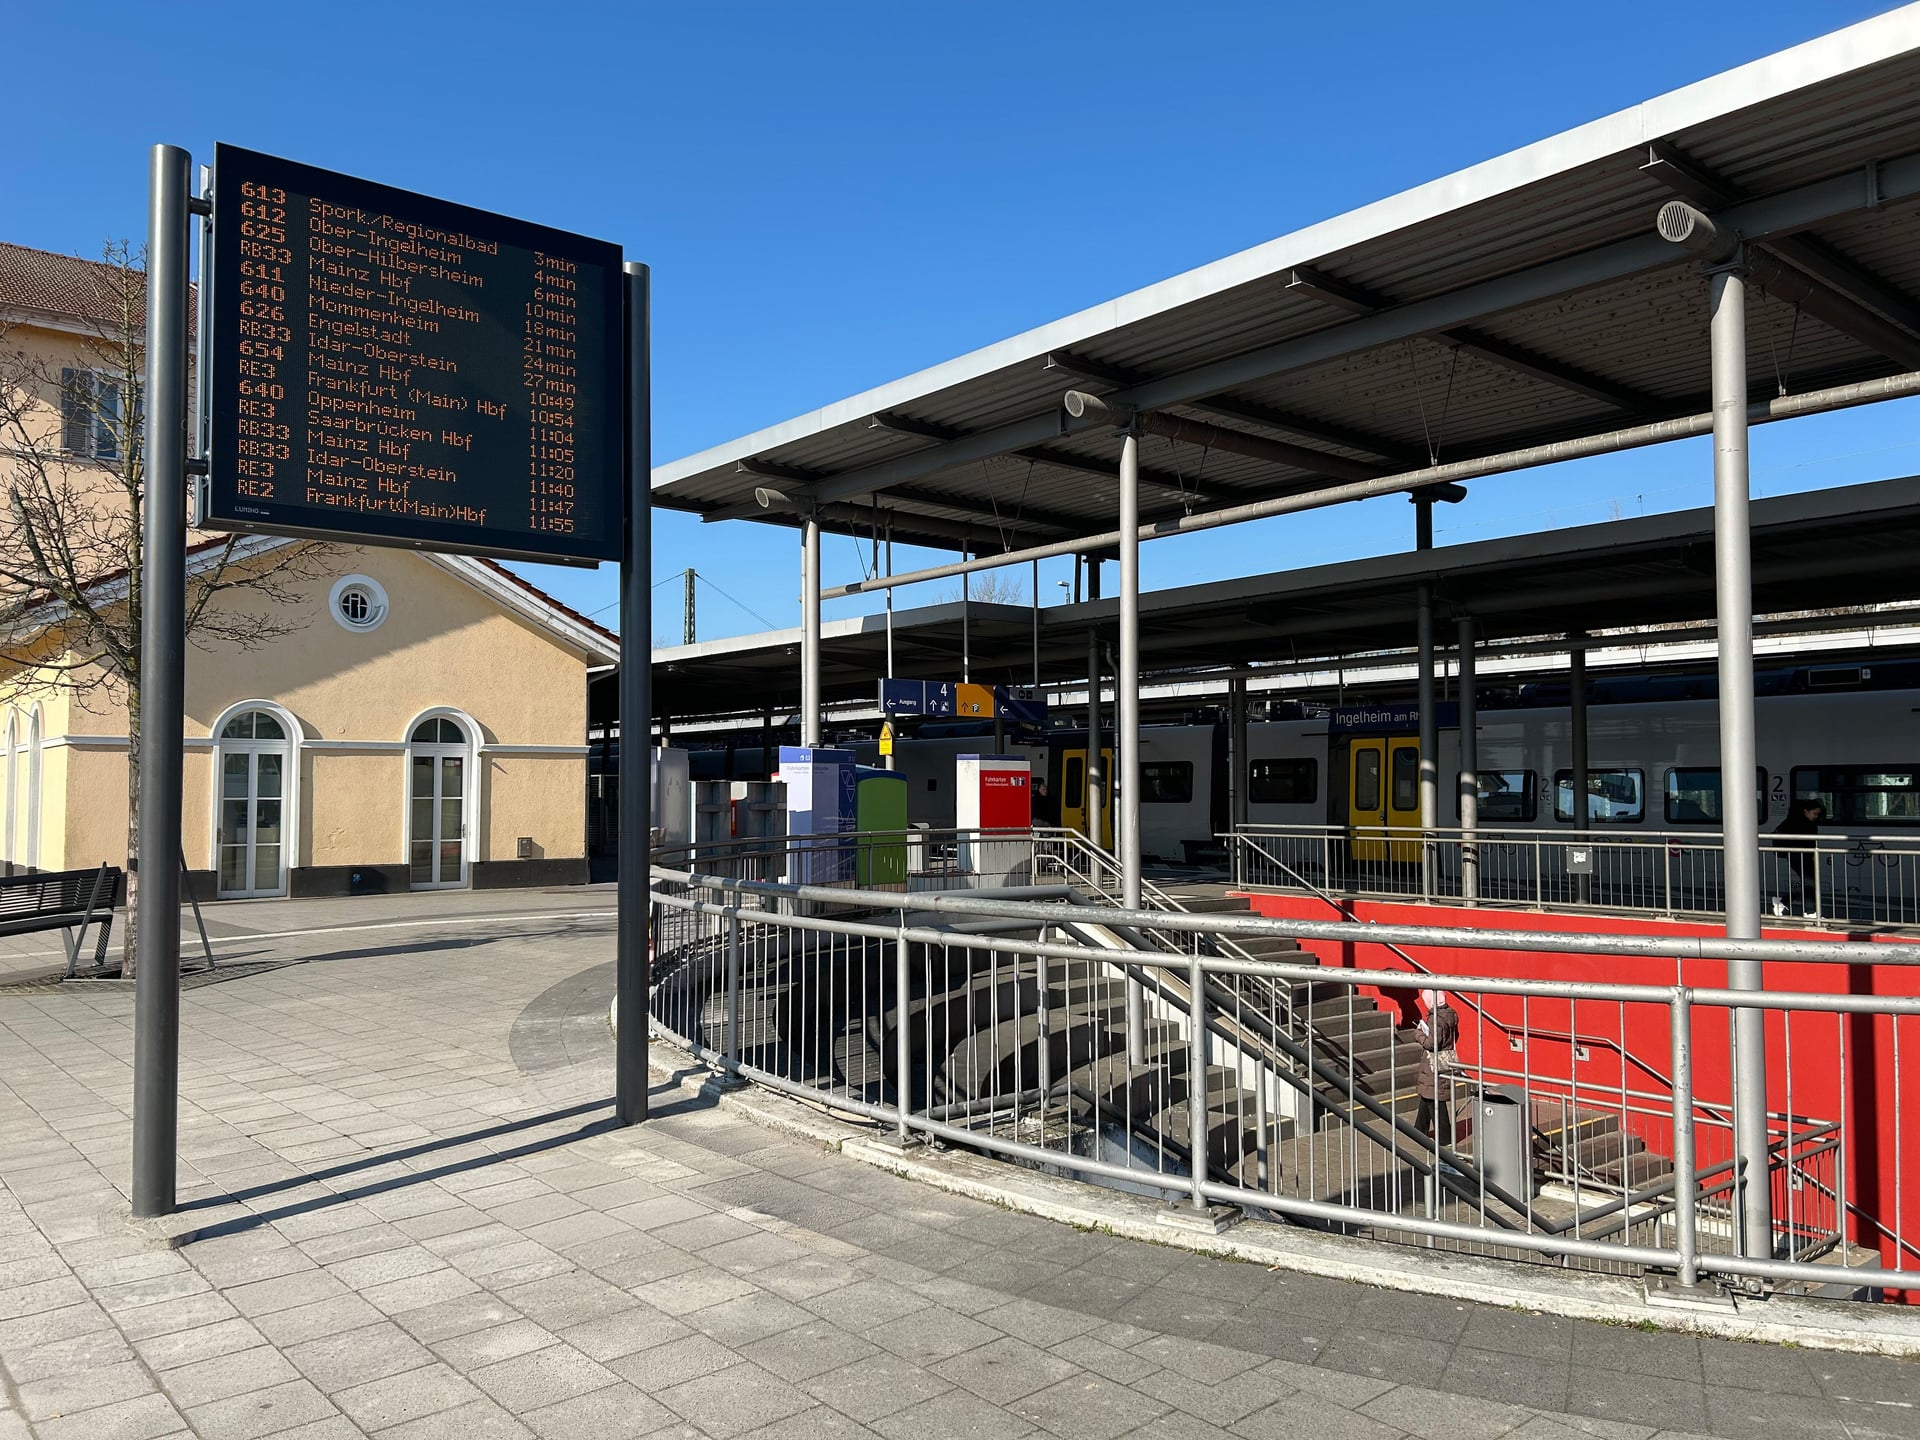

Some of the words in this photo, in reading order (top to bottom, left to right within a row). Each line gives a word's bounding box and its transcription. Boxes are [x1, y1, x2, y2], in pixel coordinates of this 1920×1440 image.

[241, 181, 285, 204] 613
[309, 198, 498, 256] Spork./Regionalbad
[241, 202, 285, 224] 612
[309, 217, 461, 264] Ober-Ingelheim
[241, 222, 285, 243] 625
[309, 237, 483, 288] Ober-Hilbersheim
[241, 240, 292, 264] RB33
[309, 256, 369, 282] Mainz
[381, 272, 411, 293] Hbf
[240, 281, 285, 302] 640
[309, 294, 439, 333] Mommenheim
[241, 261, 284, 283] 611
[309, 274, 479, 323] Nieder-Ingelheim
[240, 301, 284, 322] 626
[309, 313, 411, 346] Engelstadt
[240, 320, 291, 343] RB33
[309, 332, 457, 372] Idar-Oberstein
[240, 340, 284, 361] 654
[309, 352, 368, 376] Mainz
[379, 365, 410, 385] Hbf
[530, 391, 574, 410] 10:49
[240, 360, 275, 379] RE3
[309, 372, 398, 398] Frankfurt
[408, 388, 467, 411] (Main)
[477, 400, 506, 420] Hbf
[530, 409, 574, 428] 10:54
[239, 380, 284, 400] 640
[308, 391, 416, 420] Oppenheim
[530, 426, 574, 446] 11:04
[239, 400, 275, 418] RE3
[308, 410, 431, 441] Saarbrücken
[443, 430, 473, 451] Hbf
[530, 444, 574, 463] 11:05
[238, 440, 290, 460] RB33
[308, 449, 456, 482] Idar-Oberstein
[530, 480, 574, 498] 11:40
[239, 419, 290, 440] RB33
[308, 429, 368, 453] Mainz
[379, 440, 410, 460] Hbf
[530, 462, 574, 480] 11:20
[238, 460, 274, 478] RE3
[308, 469, 367, 491] Mainz
[378, 478, 409, 497] Hbf
[530, 497, 574, 515] 11:47
[238, 480, 274, 498] RE2
[530, 515, 574, 533] 11:55
[898, 698, 917, 706] Ausgang
[940, 683, 948, 697] 4
[1335, 710, 1391, 727] Ingelheim
[1394, 714, 1407, 722] am
[1541, 778, 1550, 793] 2
[1773, 776, 1784, 793] 2
